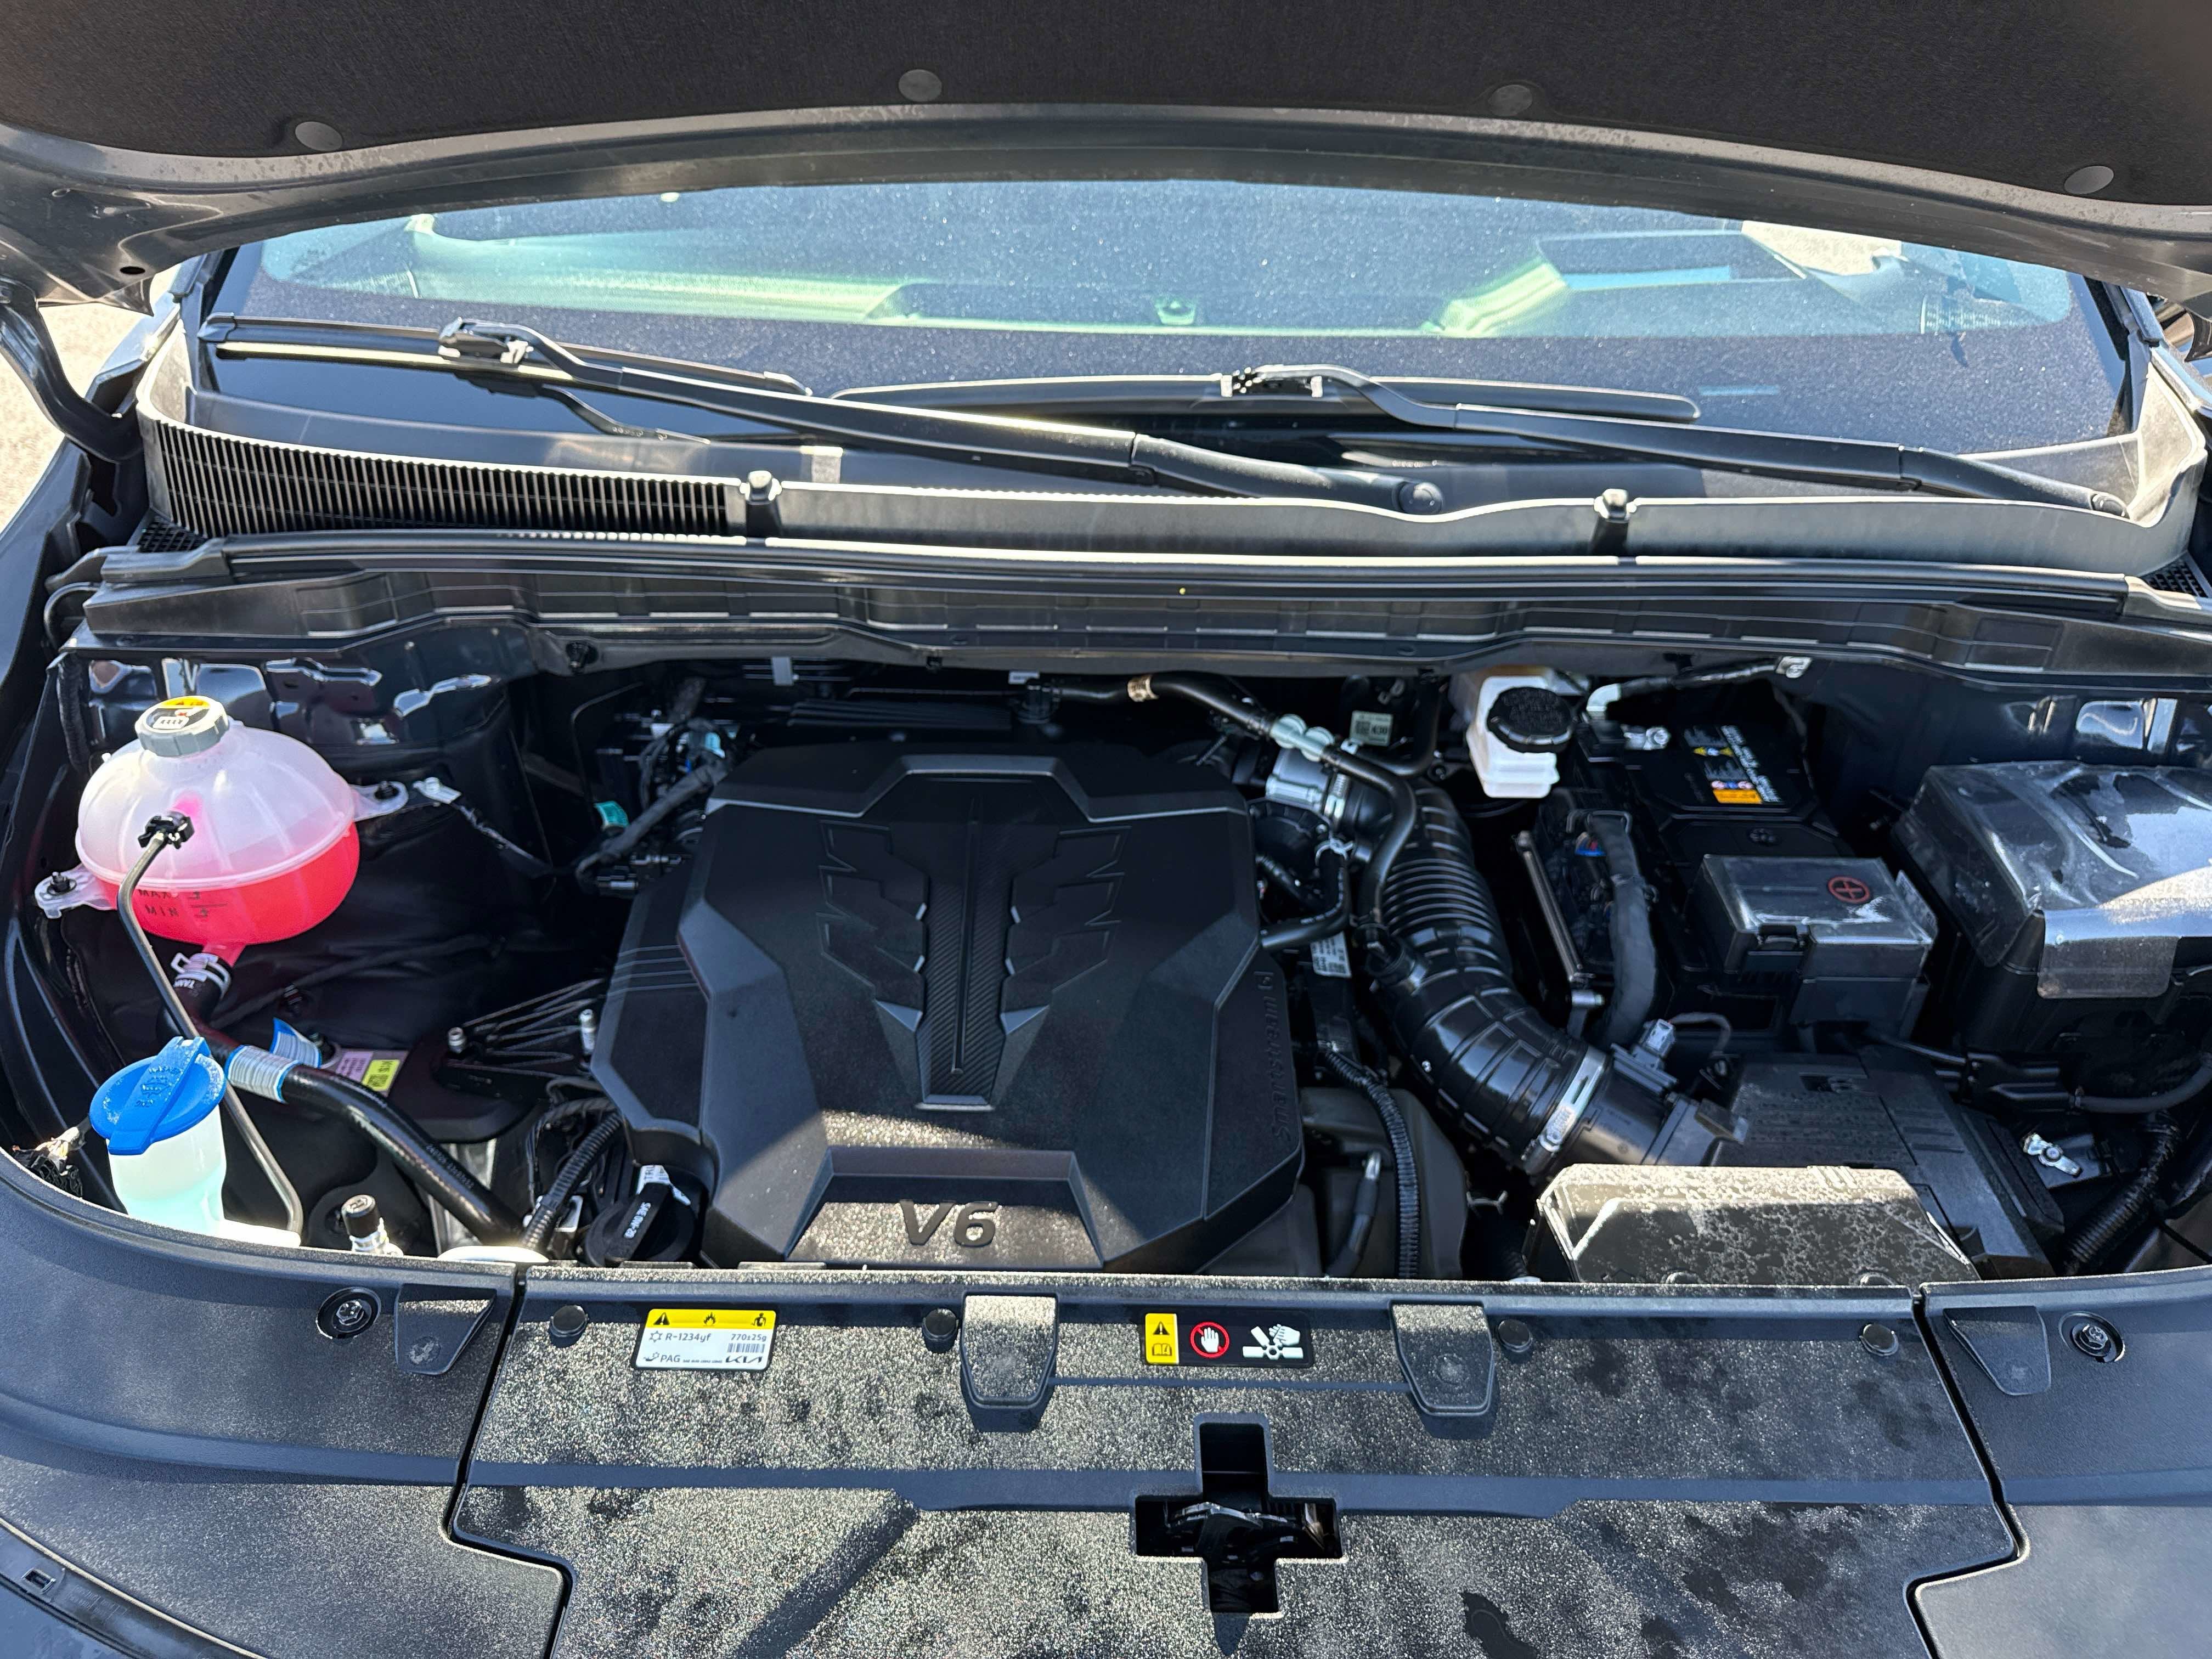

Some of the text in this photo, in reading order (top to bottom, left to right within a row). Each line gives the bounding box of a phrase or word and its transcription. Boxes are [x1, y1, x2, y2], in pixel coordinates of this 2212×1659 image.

[145, 905, 179, 917] MIN
[899, 1199, 998, 1248] V6
[665, 1333, 712, 1343] R-1234yf
[660, 1355, 681, 1363] PAG
